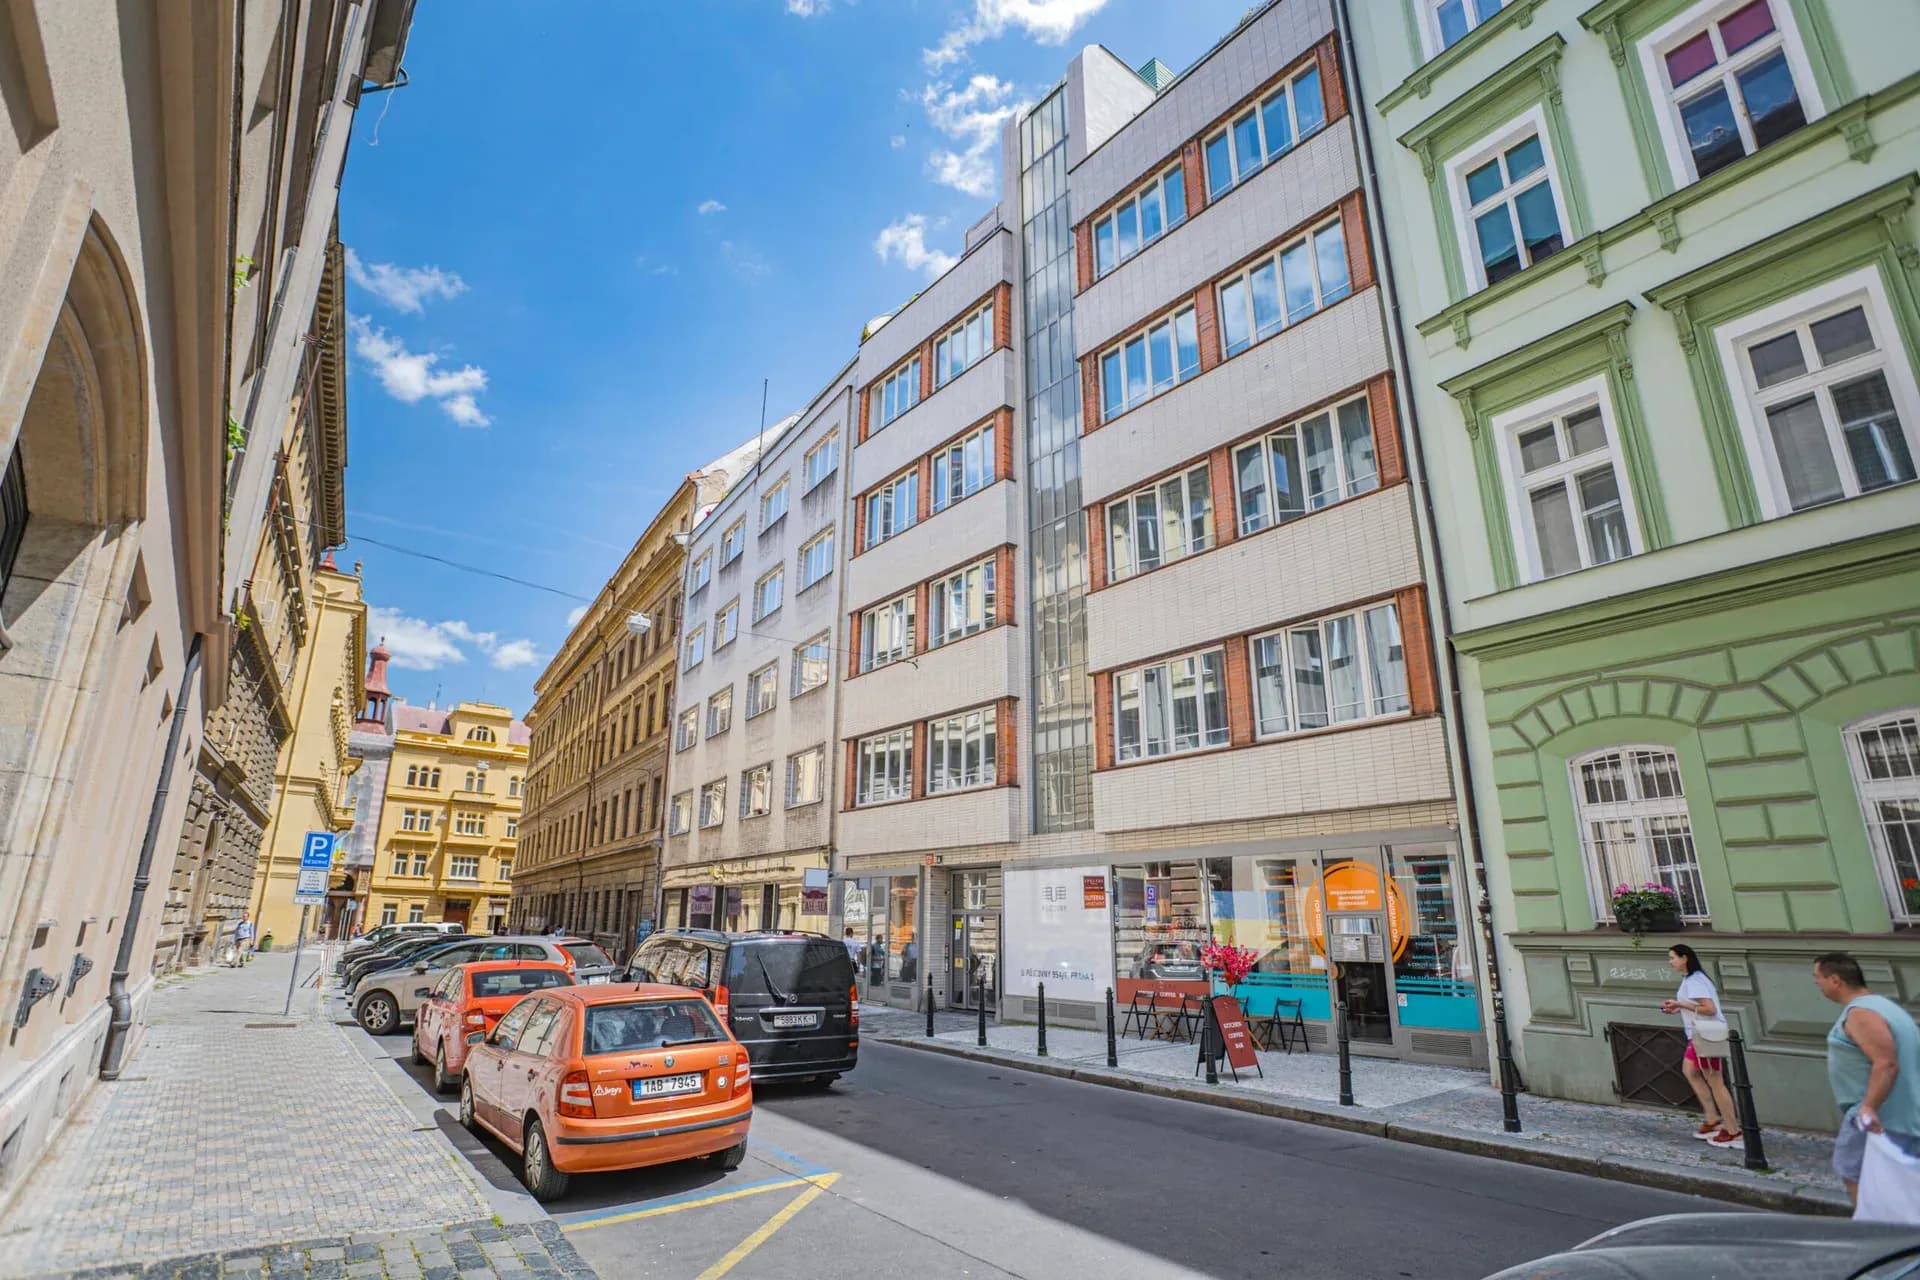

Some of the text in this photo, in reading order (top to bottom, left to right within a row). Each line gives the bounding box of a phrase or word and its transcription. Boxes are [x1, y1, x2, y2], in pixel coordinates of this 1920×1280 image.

[309, 837, 328, 857] P
[644, 1079, 663, 1093] 1AB
[671, 1075, 697, 1090] 7945
